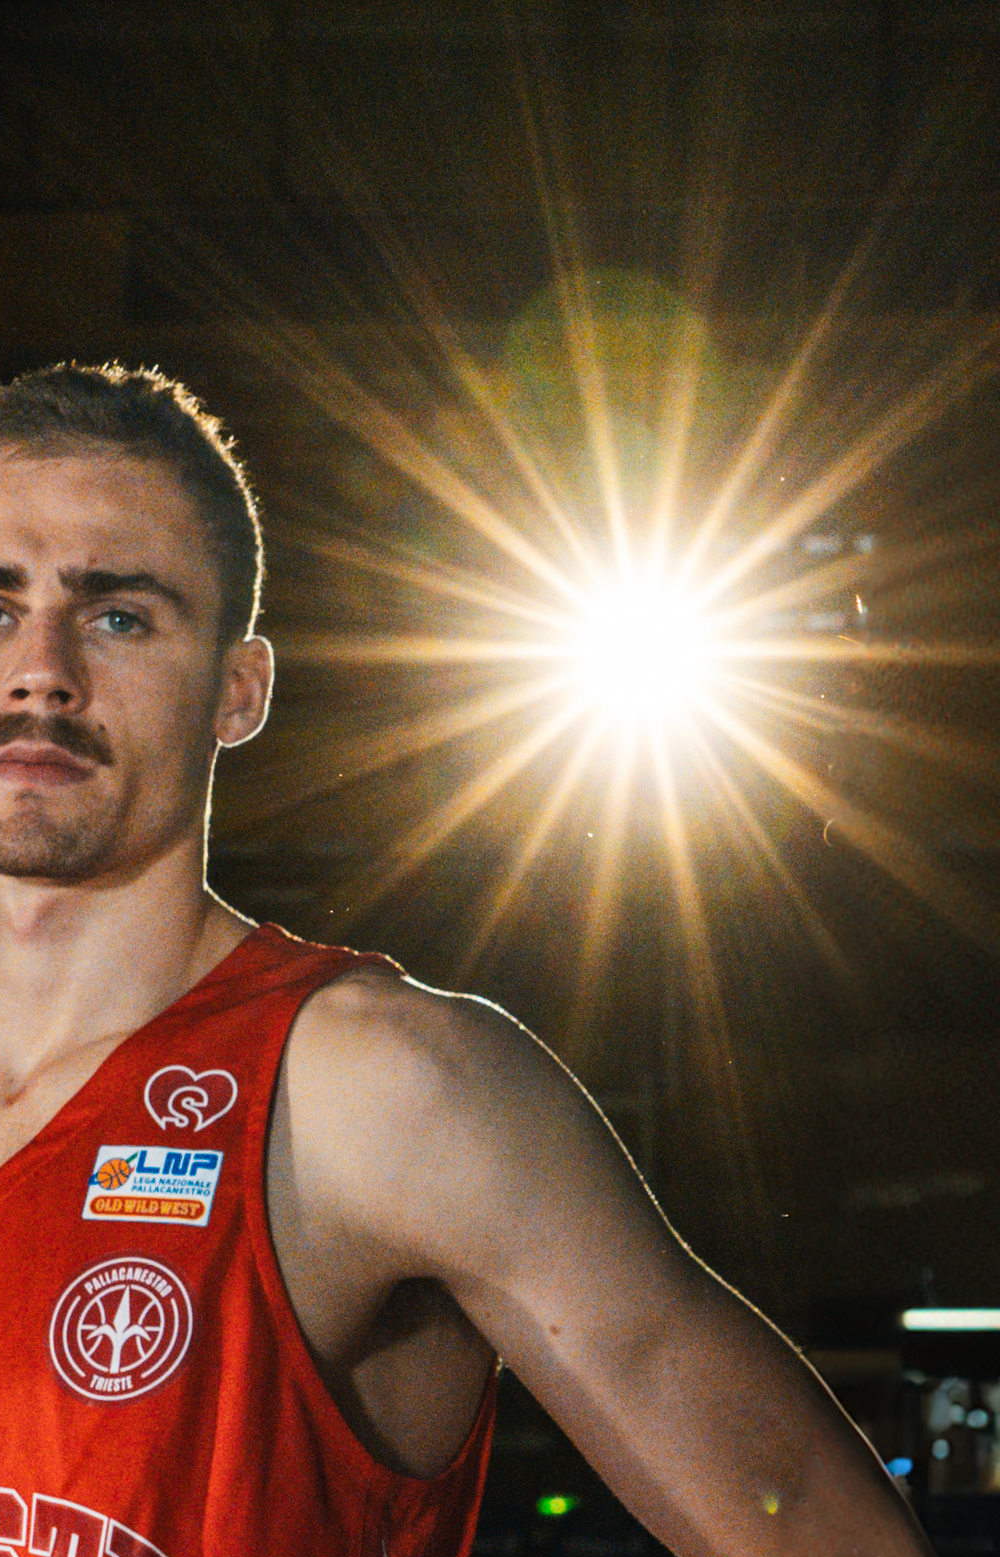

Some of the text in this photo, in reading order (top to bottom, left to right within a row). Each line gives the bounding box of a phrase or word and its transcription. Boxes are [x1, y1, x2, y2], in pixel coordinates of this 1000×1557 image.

[136, 1150, 218, 1176] LNP
[131, 1185, 211, 1197] PALLACANESTRO
[133, 1176, 212, 1188] LEGA NAZIONALE
[94, 1198, 200, 1216] OLD WILD WEST
[84, 1267, 173, 1298] PALLACANESTRO
[89, 1374, 133, 1392] TRIESTE
